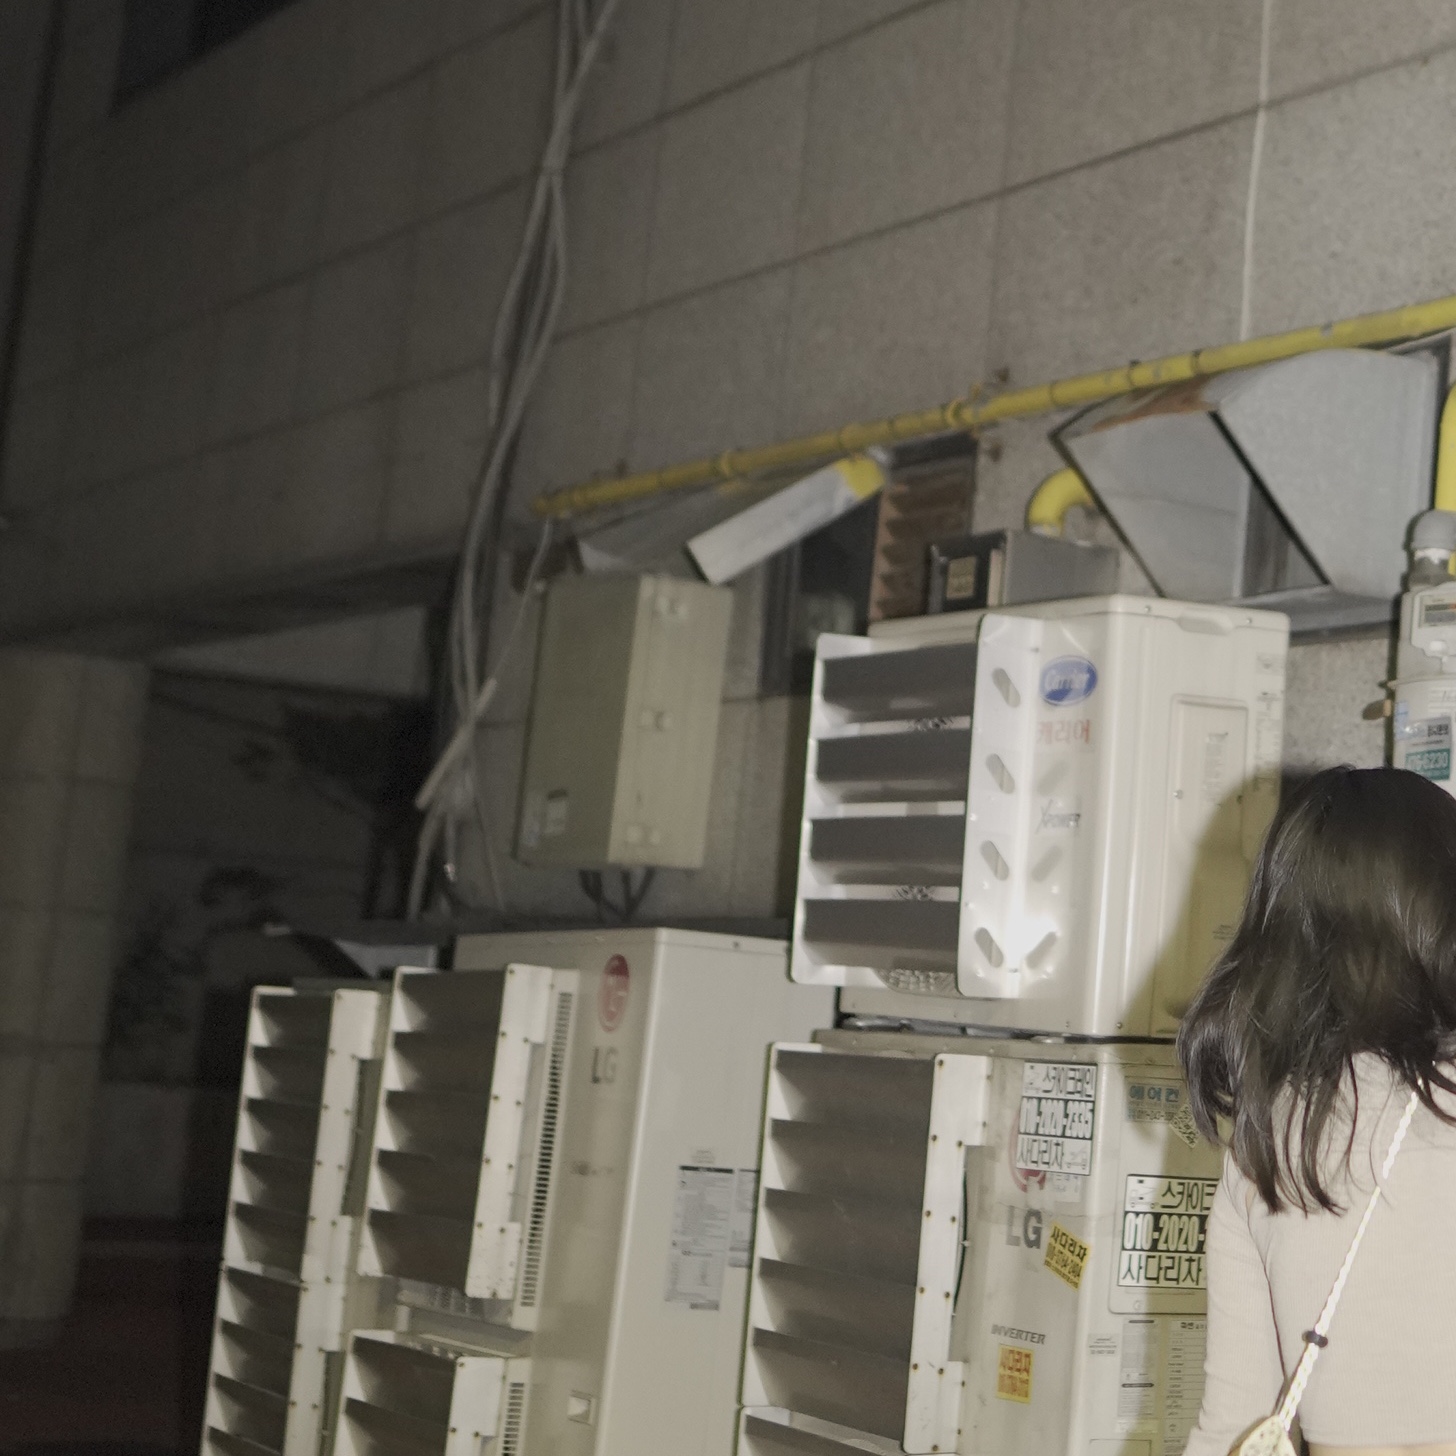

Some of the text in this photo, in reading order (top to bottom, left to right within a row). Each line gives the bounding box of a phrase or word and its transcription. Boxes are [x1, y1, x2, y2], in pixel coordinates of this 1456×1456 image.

[592, 1047, 618, 1084] LG
[1017, 1138, 1065, 1171] 사다리차
[1005, 1205, 1043, 1250] LG
[1051, 1225, 1089, 1263] 사다리차
[1123, 1212, 1207, 1252] 010-2020-
[1122, 1254, 1202, 1286] 사다리차
[991, 1324, 1046, 1345] INVERTER
